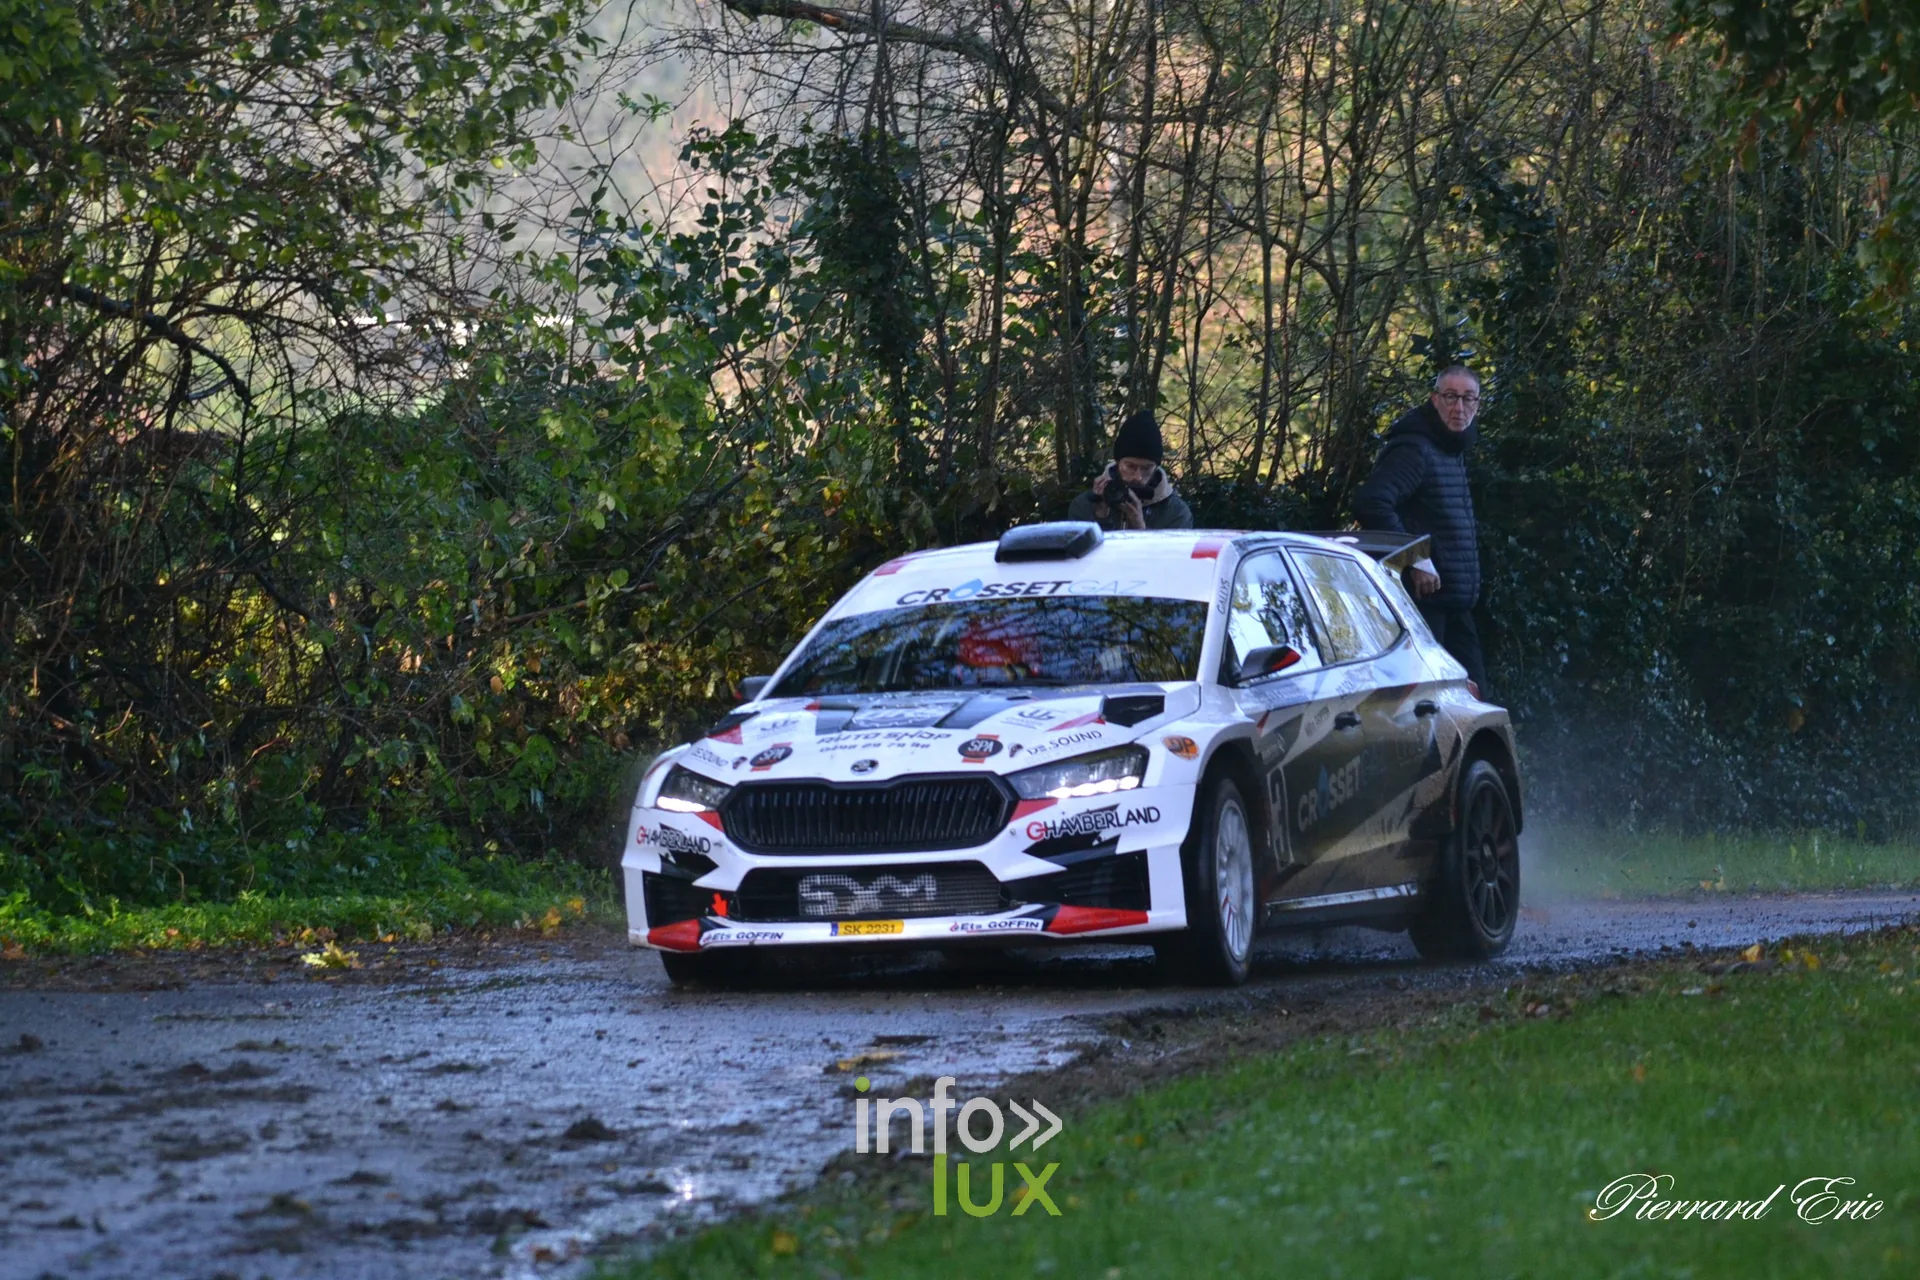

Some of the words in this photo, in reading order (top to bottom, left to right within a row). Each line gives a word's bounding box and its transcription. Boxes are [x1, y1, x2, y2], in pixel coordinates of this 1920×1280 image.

[882, 730, 954, 742] SHOP
[967, 739, 995, 754] SPA
[843, 925, 862, 935] SK
[866, 924, 895, 934] 2231
[987, 920, 1040, 930] GOFFIN
[736, 931, 784, 940] GOFFIN
